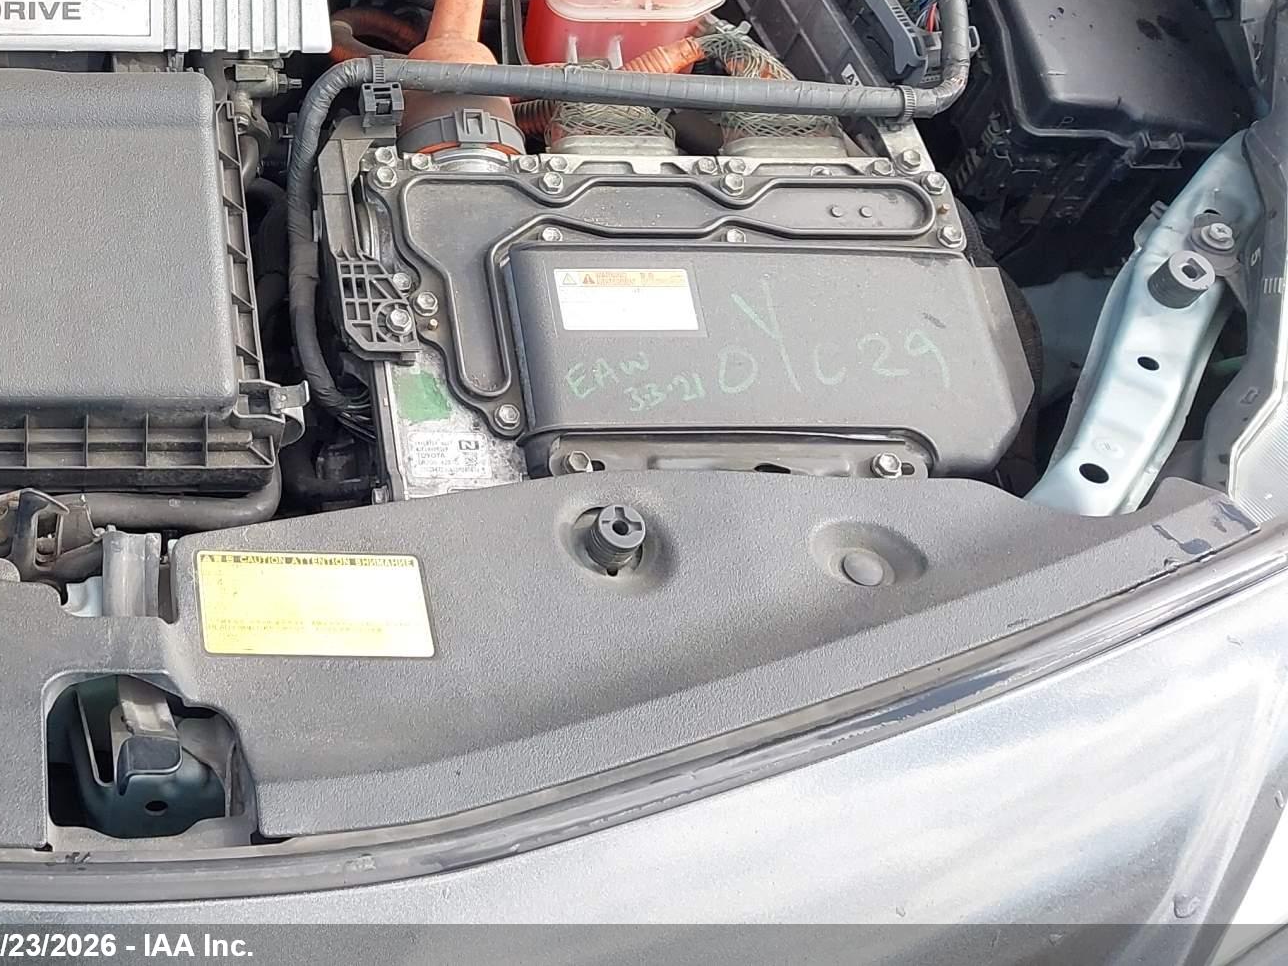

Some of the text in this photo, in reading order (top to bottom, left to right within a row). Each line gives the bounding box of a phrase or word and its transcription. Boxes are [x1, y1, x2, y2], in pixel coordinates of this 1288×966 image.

[240, 555, 286, 565] CAUTION
[291, 556, 352, 566] ATTENTION
[355, 557, 415, 567] ВНИМАНИЕ
